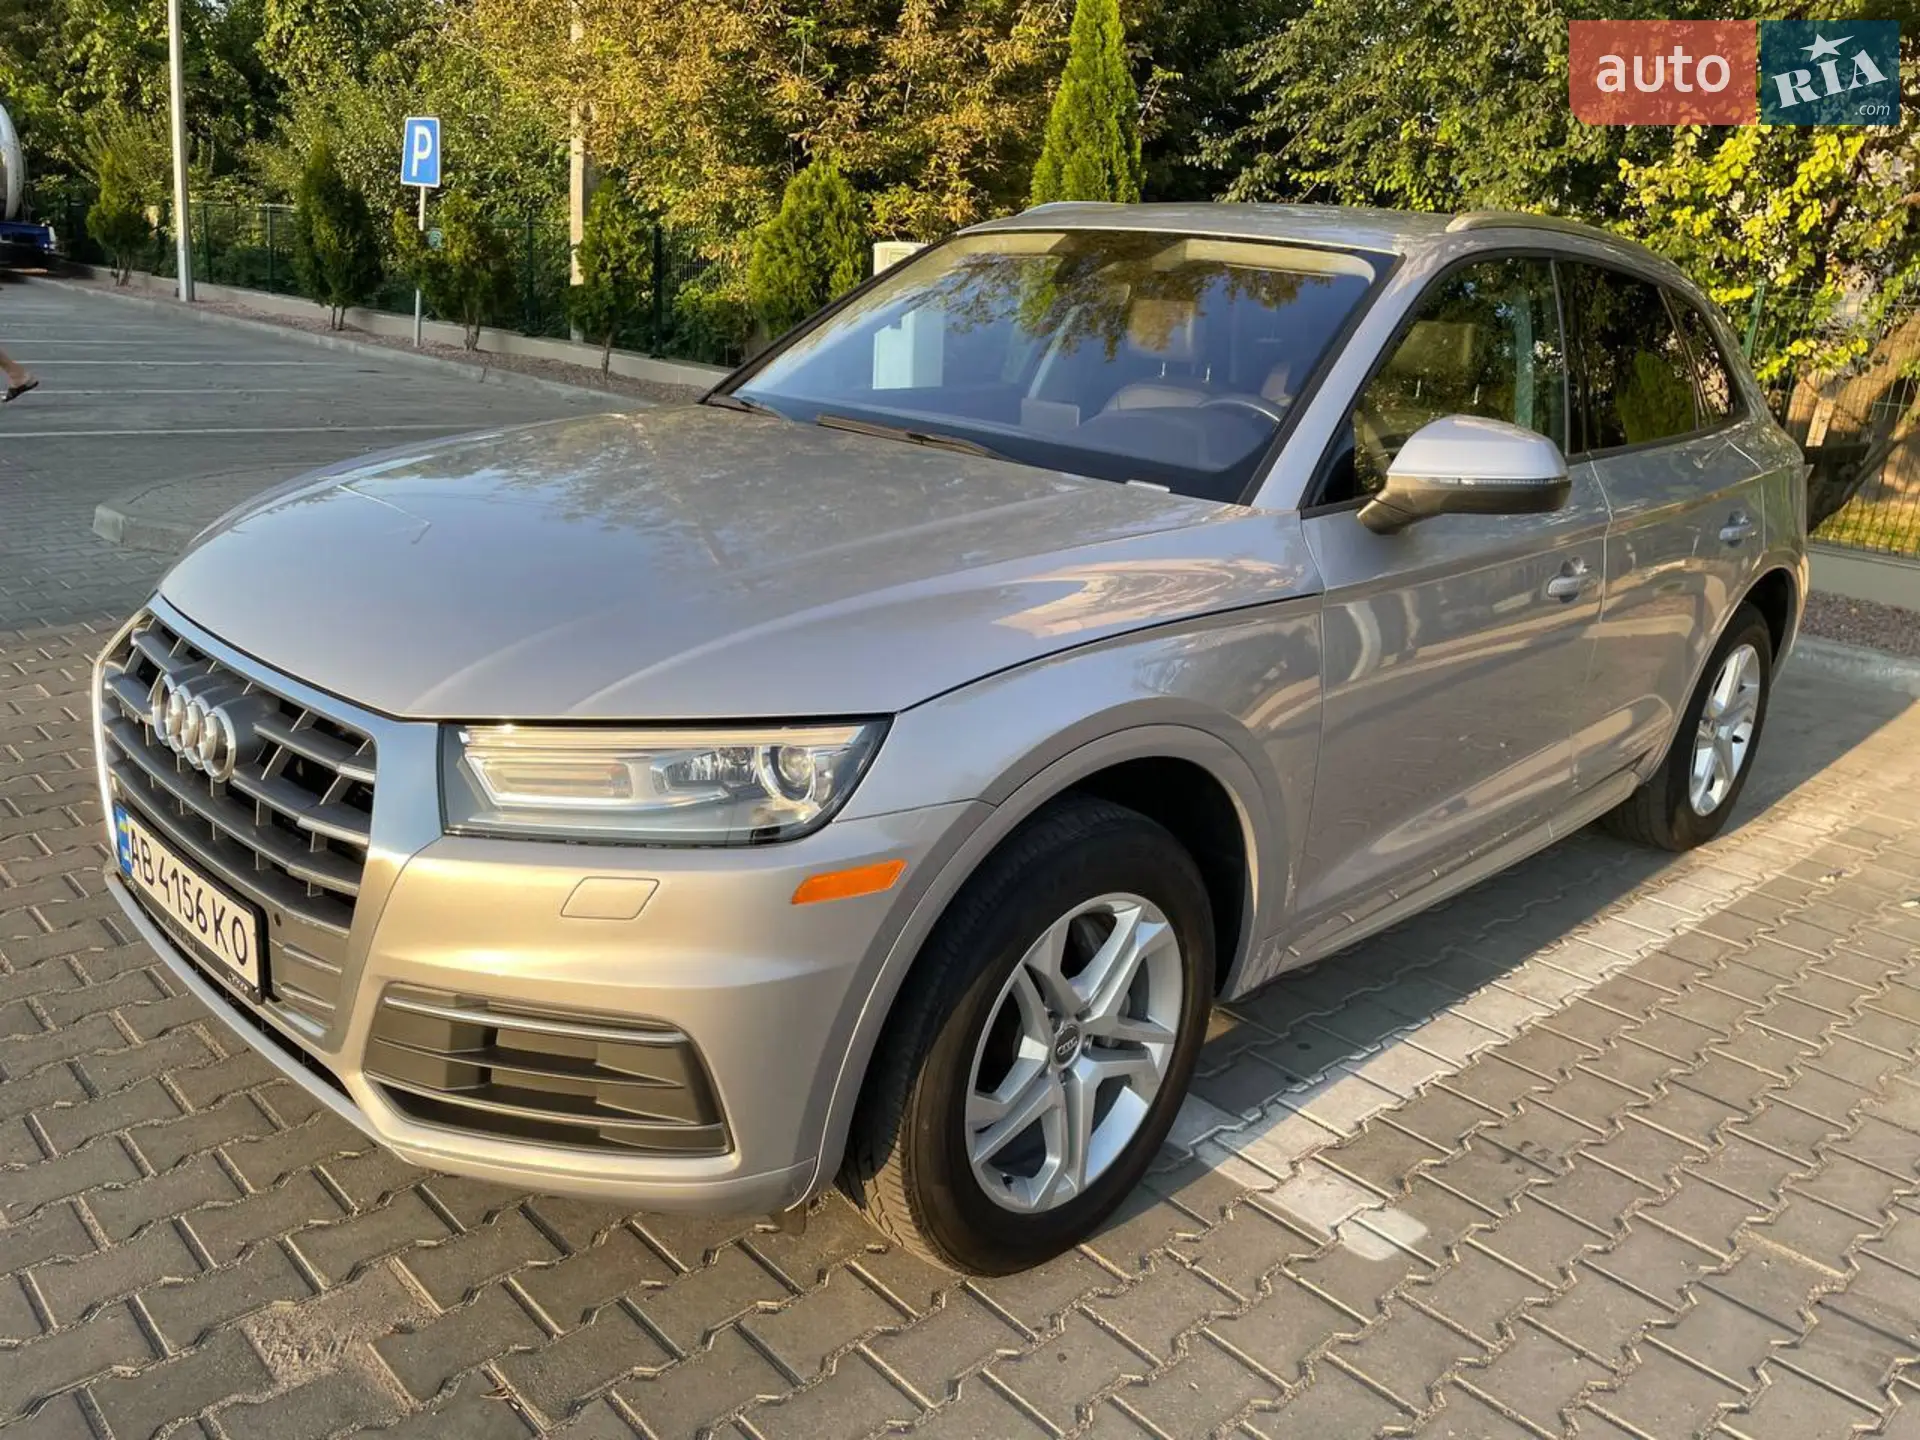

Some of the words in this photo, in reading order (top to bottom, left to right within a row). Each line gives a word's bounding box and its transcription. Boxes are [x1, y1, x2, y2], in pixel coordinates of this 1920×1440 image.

[411, 125, 432, 176] P
[130, 828, 154, 887] AB
[158, 856, 208, 934] 4156
[212, 898, 248, 966] KO
